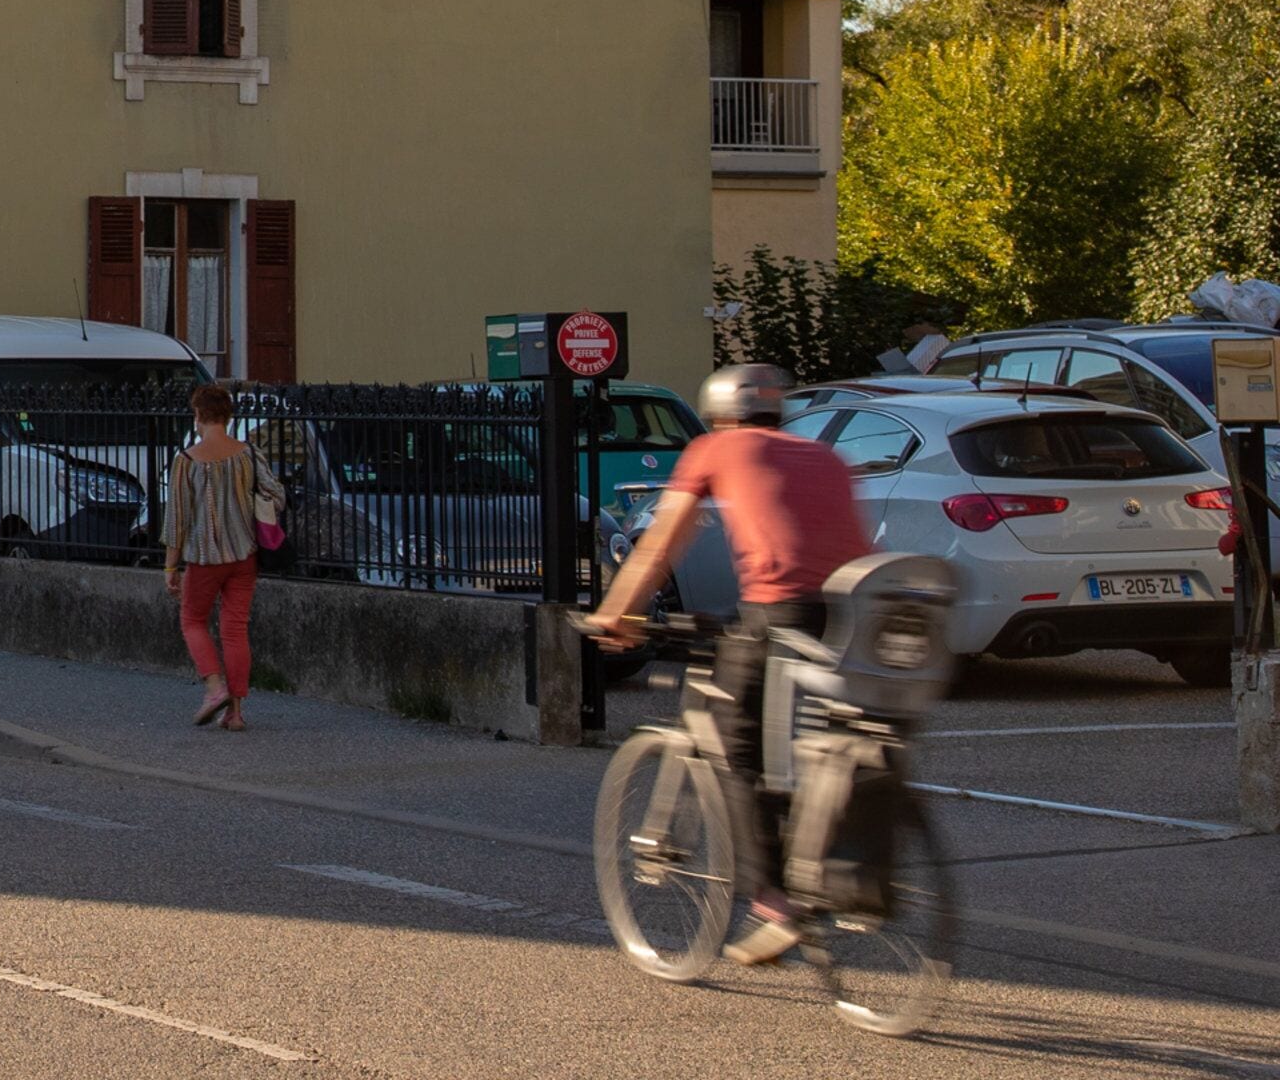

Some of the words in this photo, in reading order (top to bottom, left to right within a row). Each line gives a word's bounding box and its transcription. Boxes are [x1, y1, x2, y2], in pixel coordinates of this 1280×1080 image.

[565, 316, 607, 332] PROPRIETE
[574, 329, 598, 338] PRIVEE
[572, 349, 602, 358] DEFENSE
